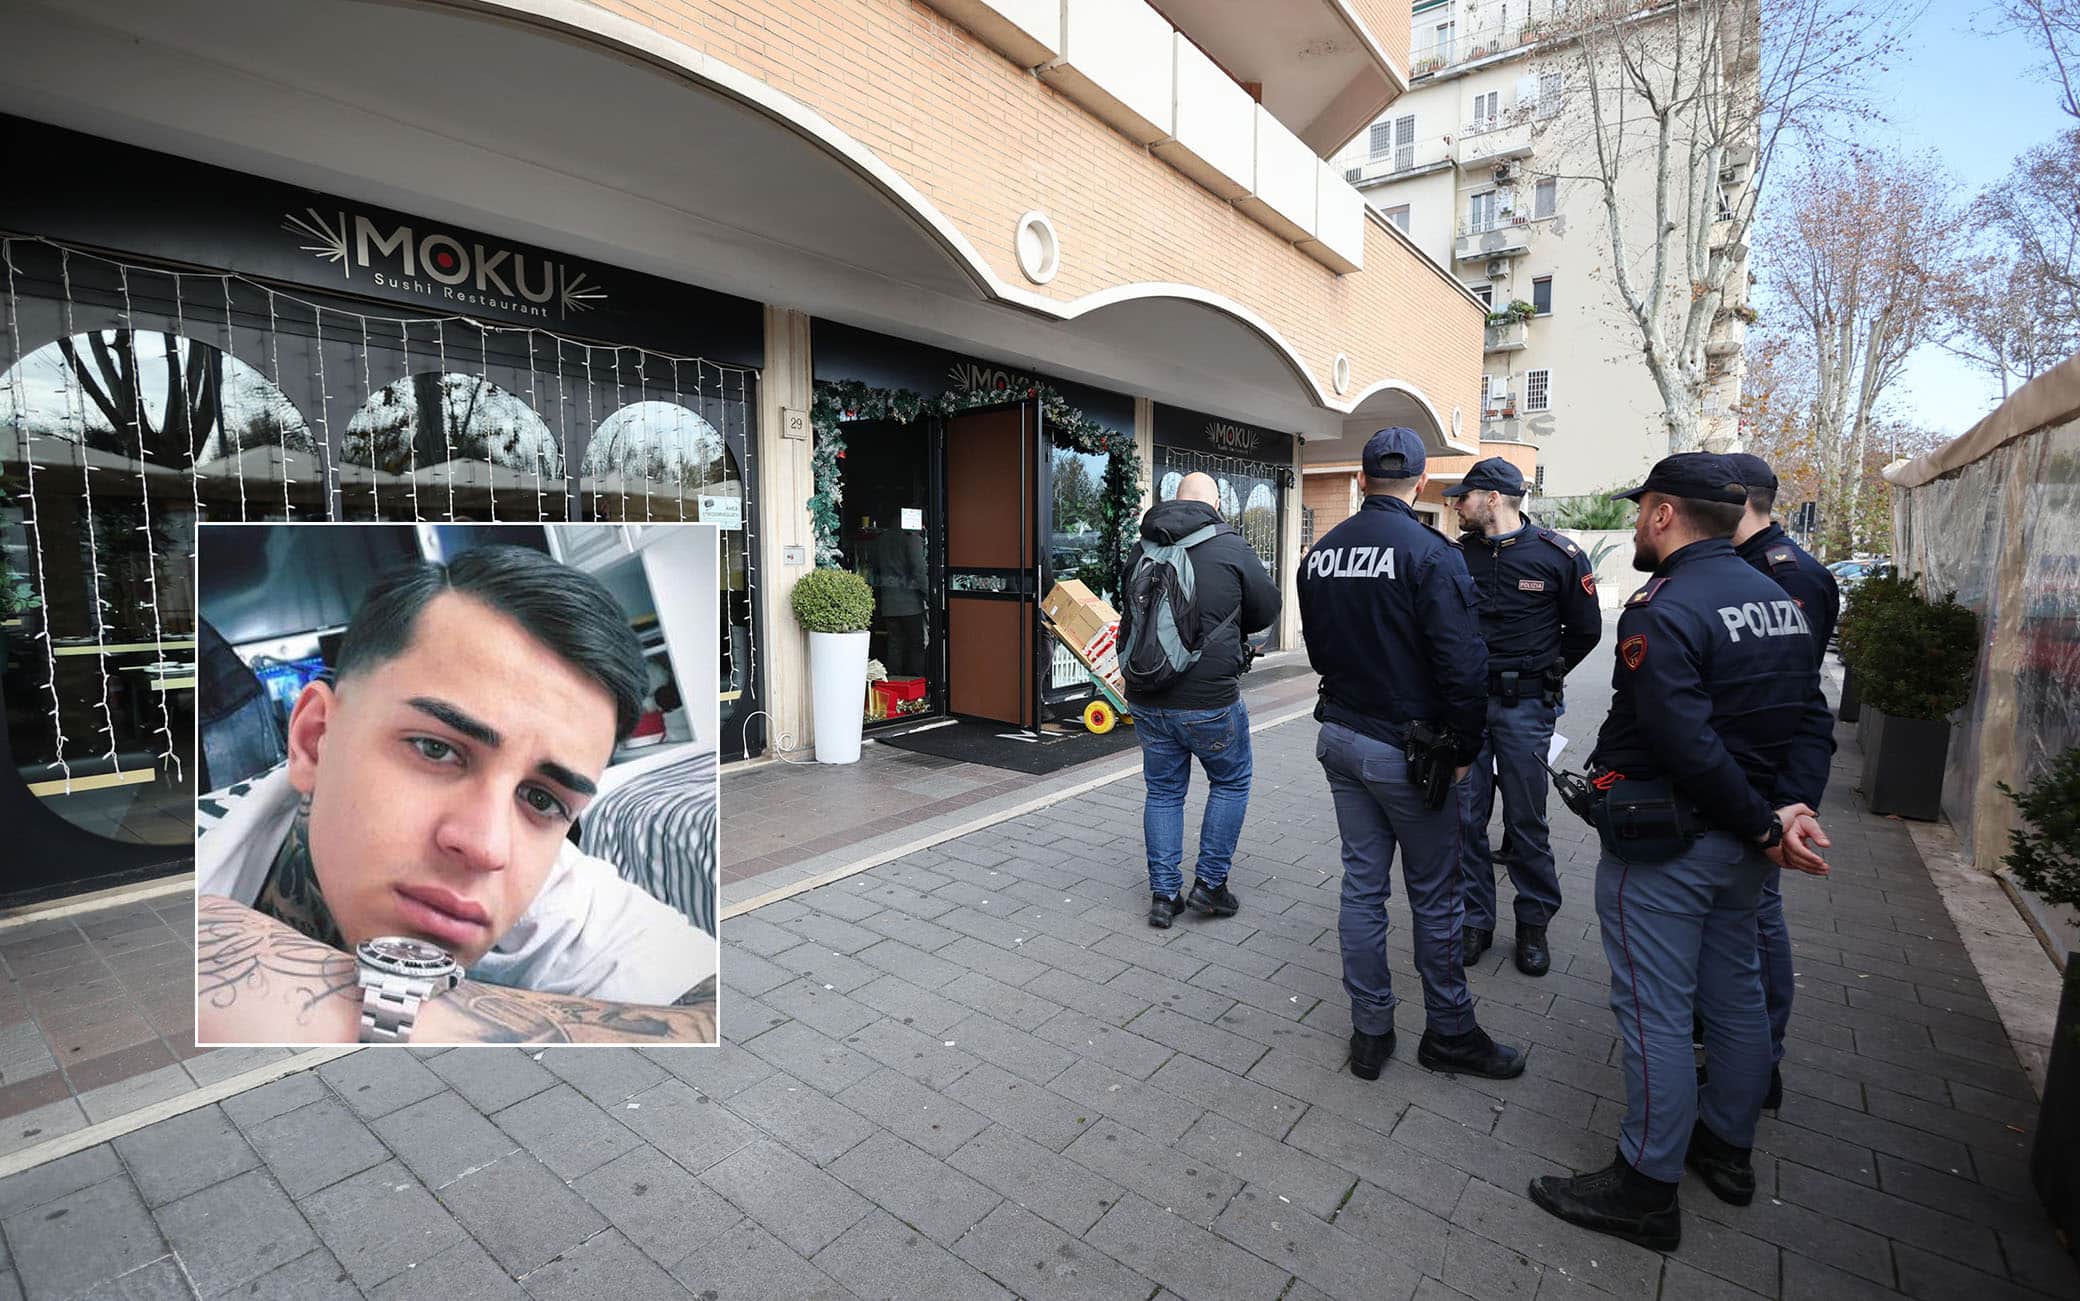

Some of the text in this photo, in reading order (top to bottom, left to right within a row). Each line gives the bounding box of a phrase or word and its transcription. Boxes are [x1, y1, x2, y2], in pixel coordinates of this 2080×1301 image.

[355, 215, 554, 304] MOKU
[374, 272, 548, 318] Sushi Restaurant
[790, 417, 803, 430] 29
[1215, 423, 1250, 449] MOKU
[1307, 546, 1396, 580] POLIZIA
